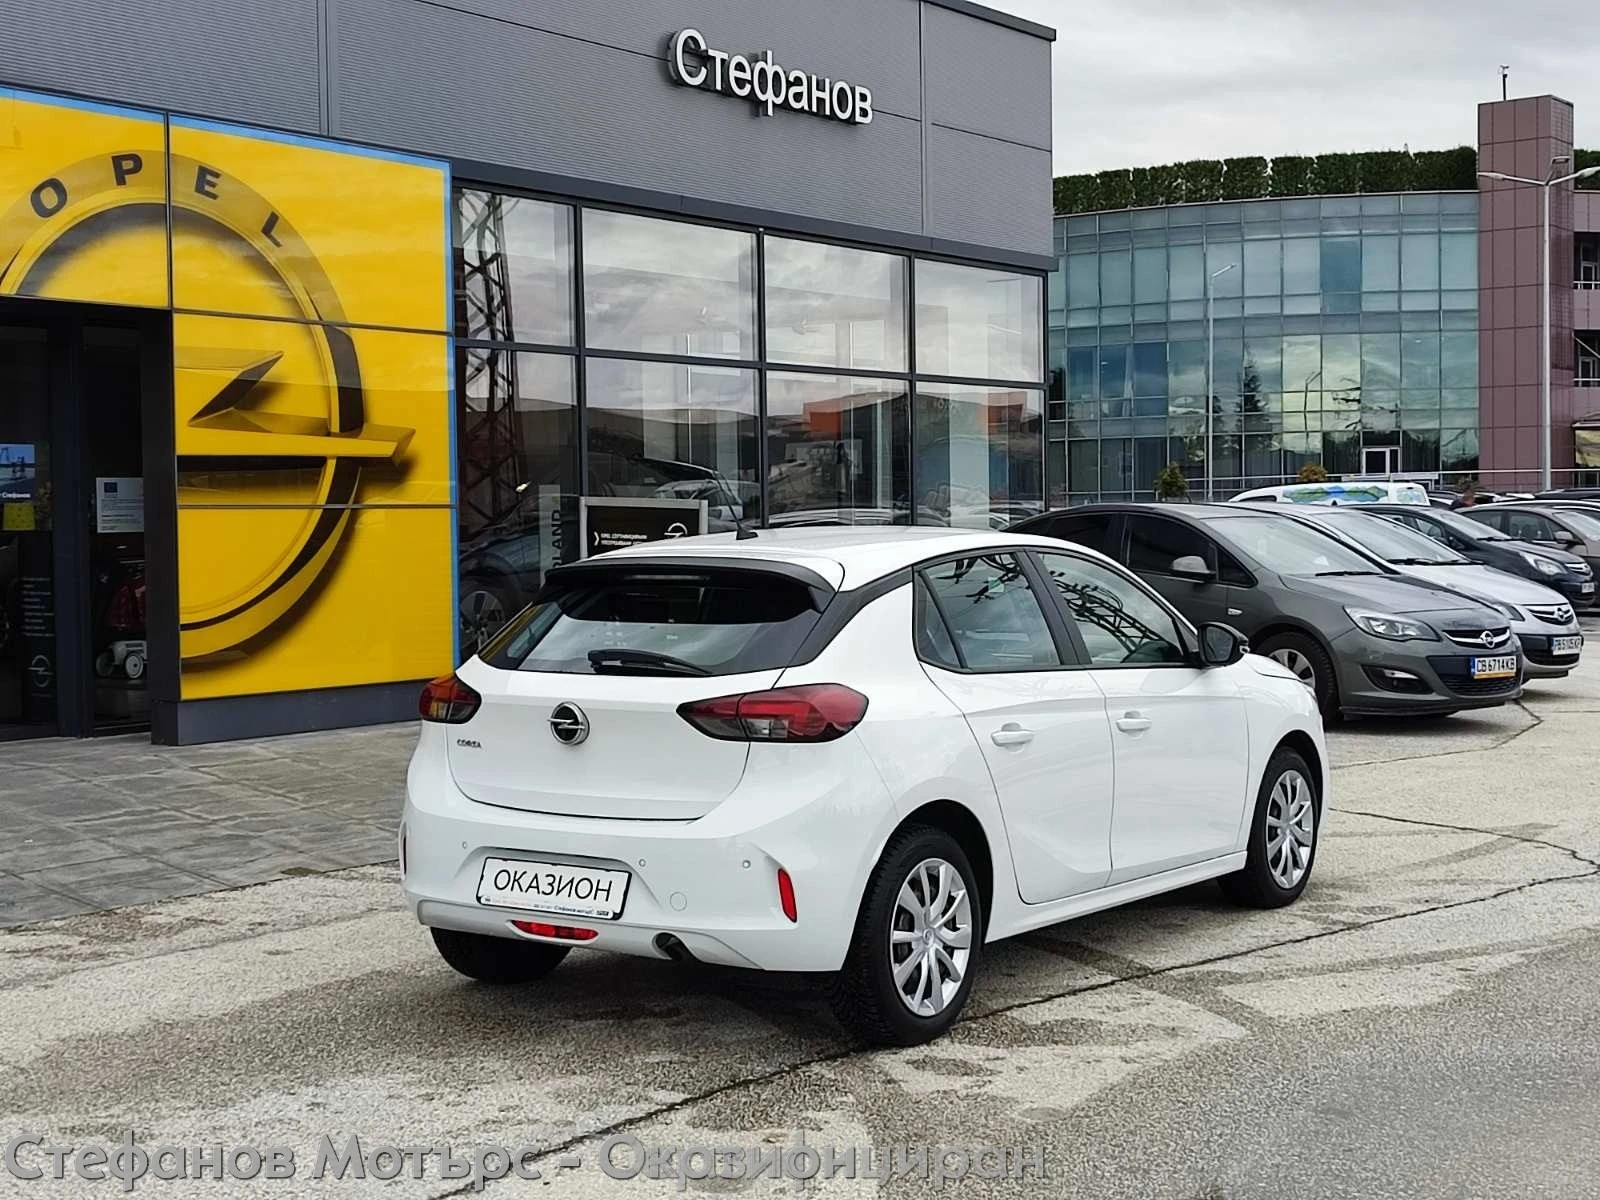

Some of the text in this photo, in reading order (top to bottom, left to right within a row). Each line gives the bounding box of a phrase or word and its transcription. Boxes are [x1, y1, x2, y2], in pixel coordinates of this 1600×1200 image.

[670, 28, 873, 124] Стефанов
[30, 153, 284, 248] OPEL
[493, 869, 613, 902] ОКАЗИОН
